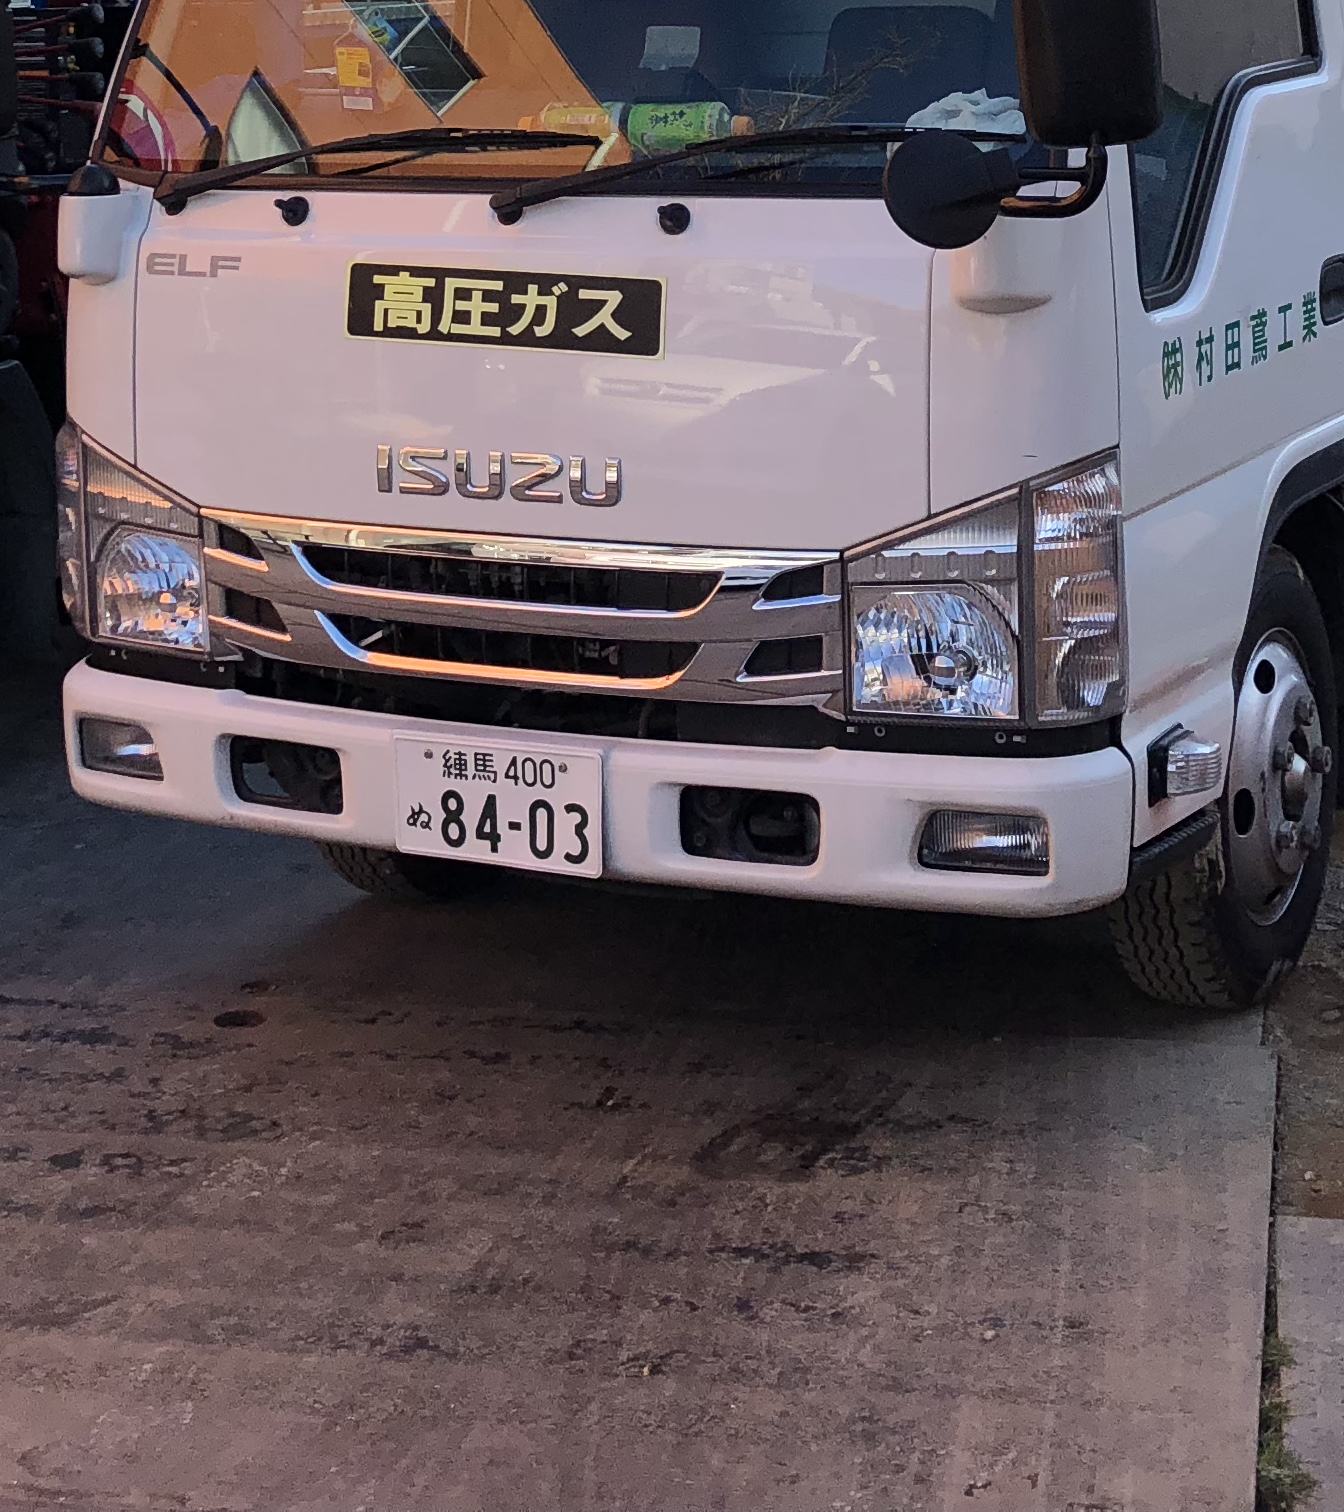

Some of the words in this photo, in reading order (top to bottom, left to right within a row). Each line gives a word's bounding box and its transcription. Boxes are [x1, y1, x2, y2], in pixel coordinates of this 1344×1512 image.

[145, 251, 243, 278] ELF
[372, 271, 633, 341] 高圧ガス
[375, 443, 623, 508] ISUZU
[440, 789, 591, 865] 84-03
